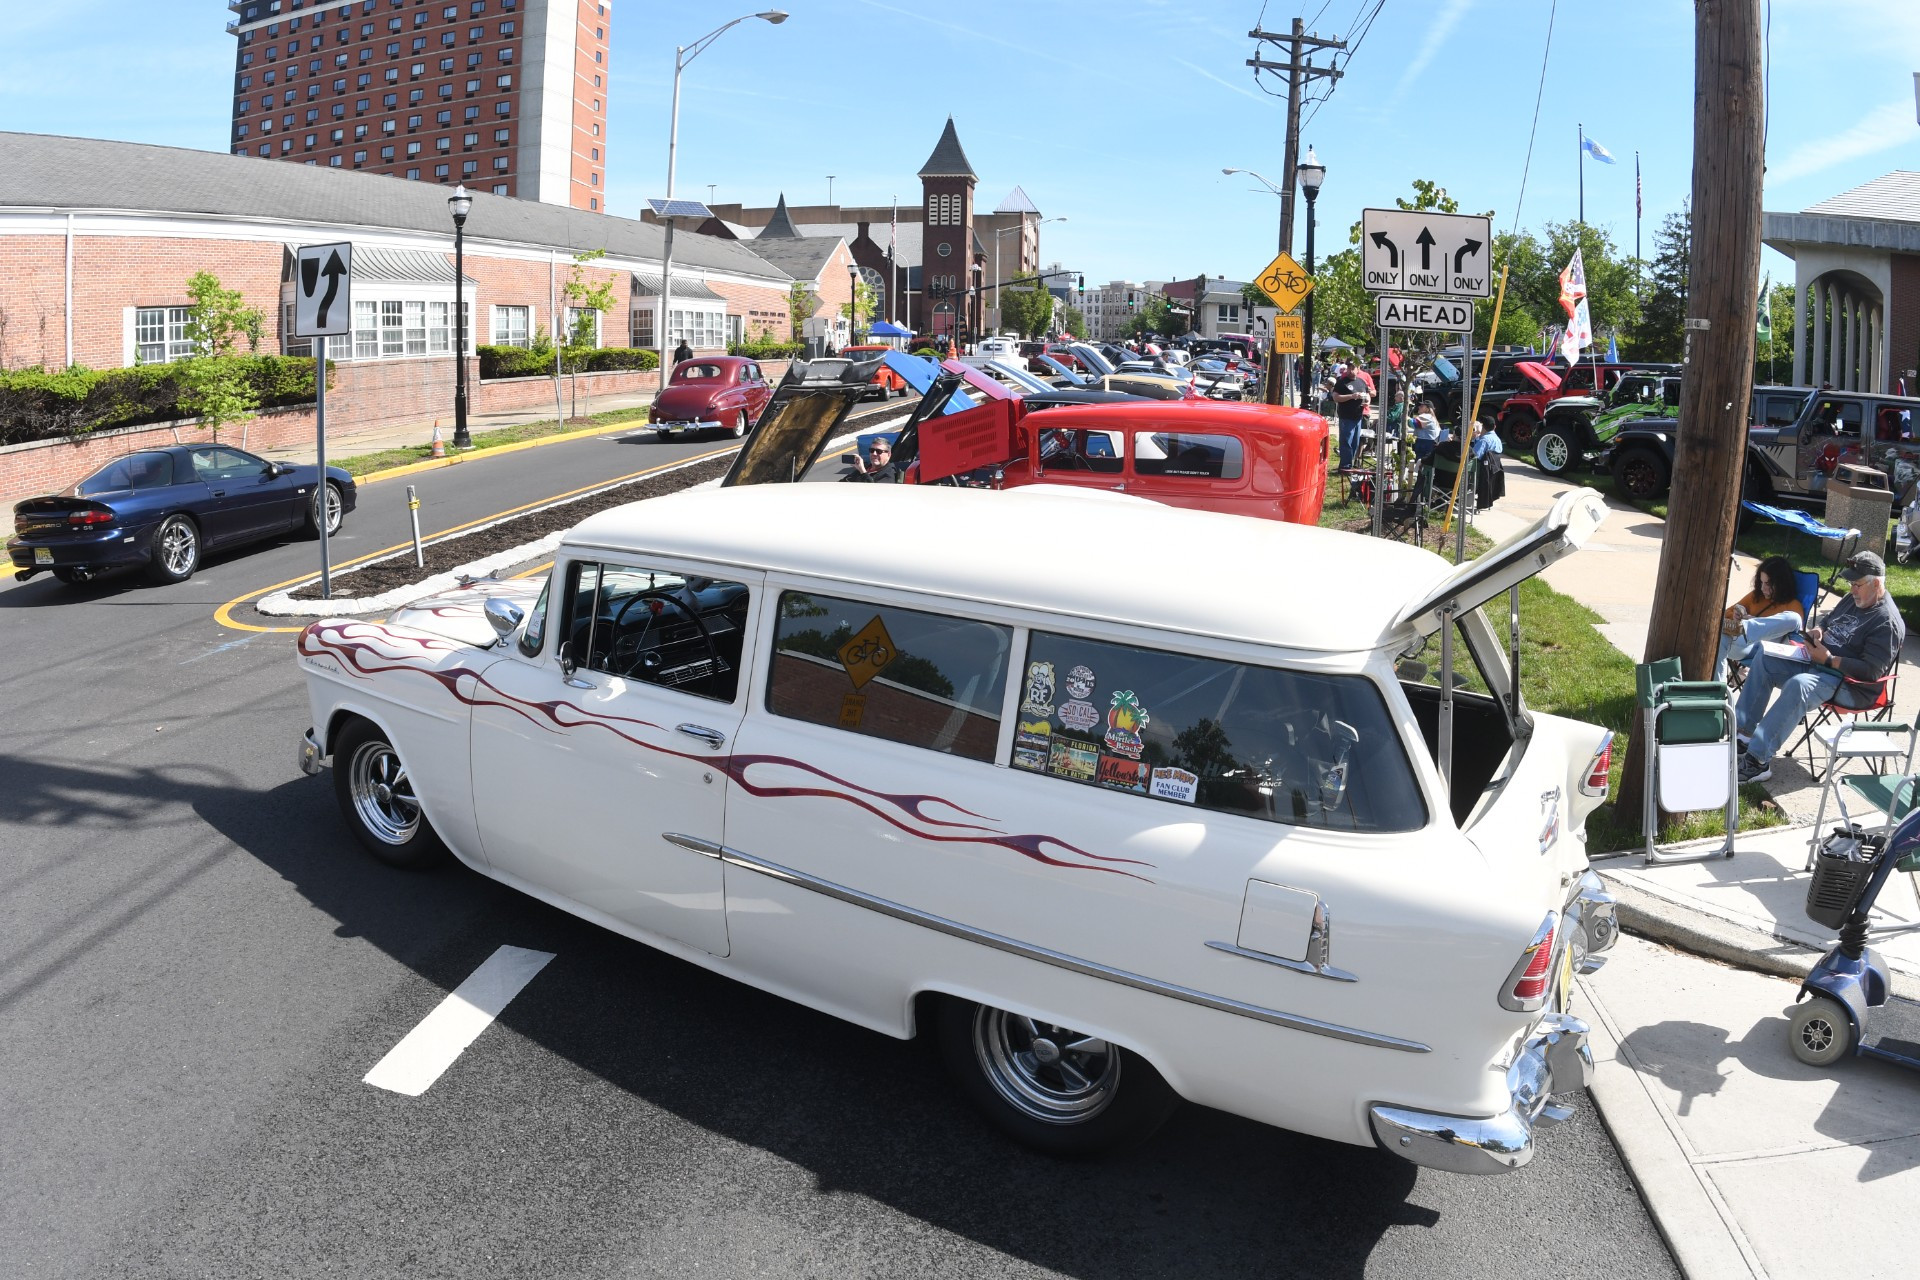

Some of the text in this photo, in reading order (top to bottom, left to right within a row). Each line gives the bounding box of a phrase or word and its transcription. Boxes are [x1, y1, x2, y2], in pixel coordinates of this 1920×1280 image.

[1368, 271, 1483, 290] ONLY ONLY ONLY
[1385, 303, 1467, 325] AHEAD
[1277, 320, 1300, 328] SHARE
[1280, 341, 1299, 349] ROAD
[1071, 741, 1097, 752] FLORIDA
[1116, 742, 1139, 753] Beach
[1099, 760, 1149, 783] Yellowstone
[1156, 781, 1190, 794] FAN CLUB
[1158, 788, 1187, 800] MEMBER
